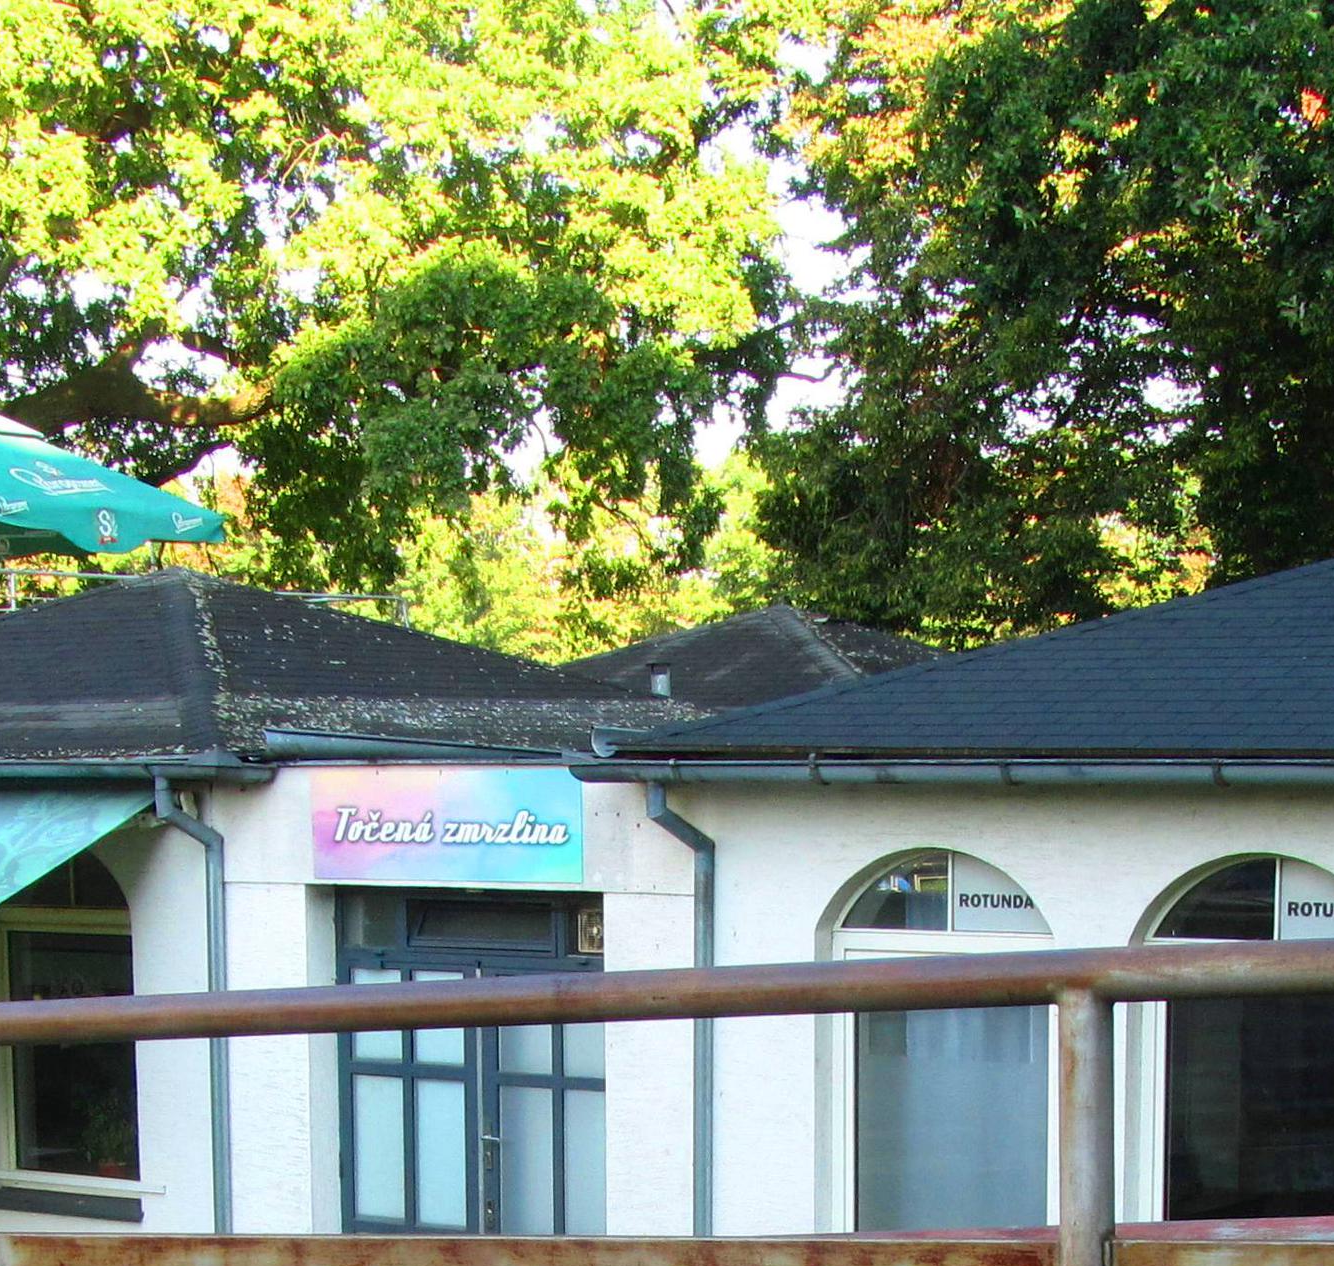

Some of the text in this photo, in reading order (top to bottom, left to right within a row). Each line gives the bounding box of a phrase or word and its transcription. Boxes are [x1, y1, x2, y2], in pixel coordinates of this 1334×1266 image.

[333, 806, 571, 846] Točená zmrzlina
[959, 893, 1035, 910] ROTUNDA
